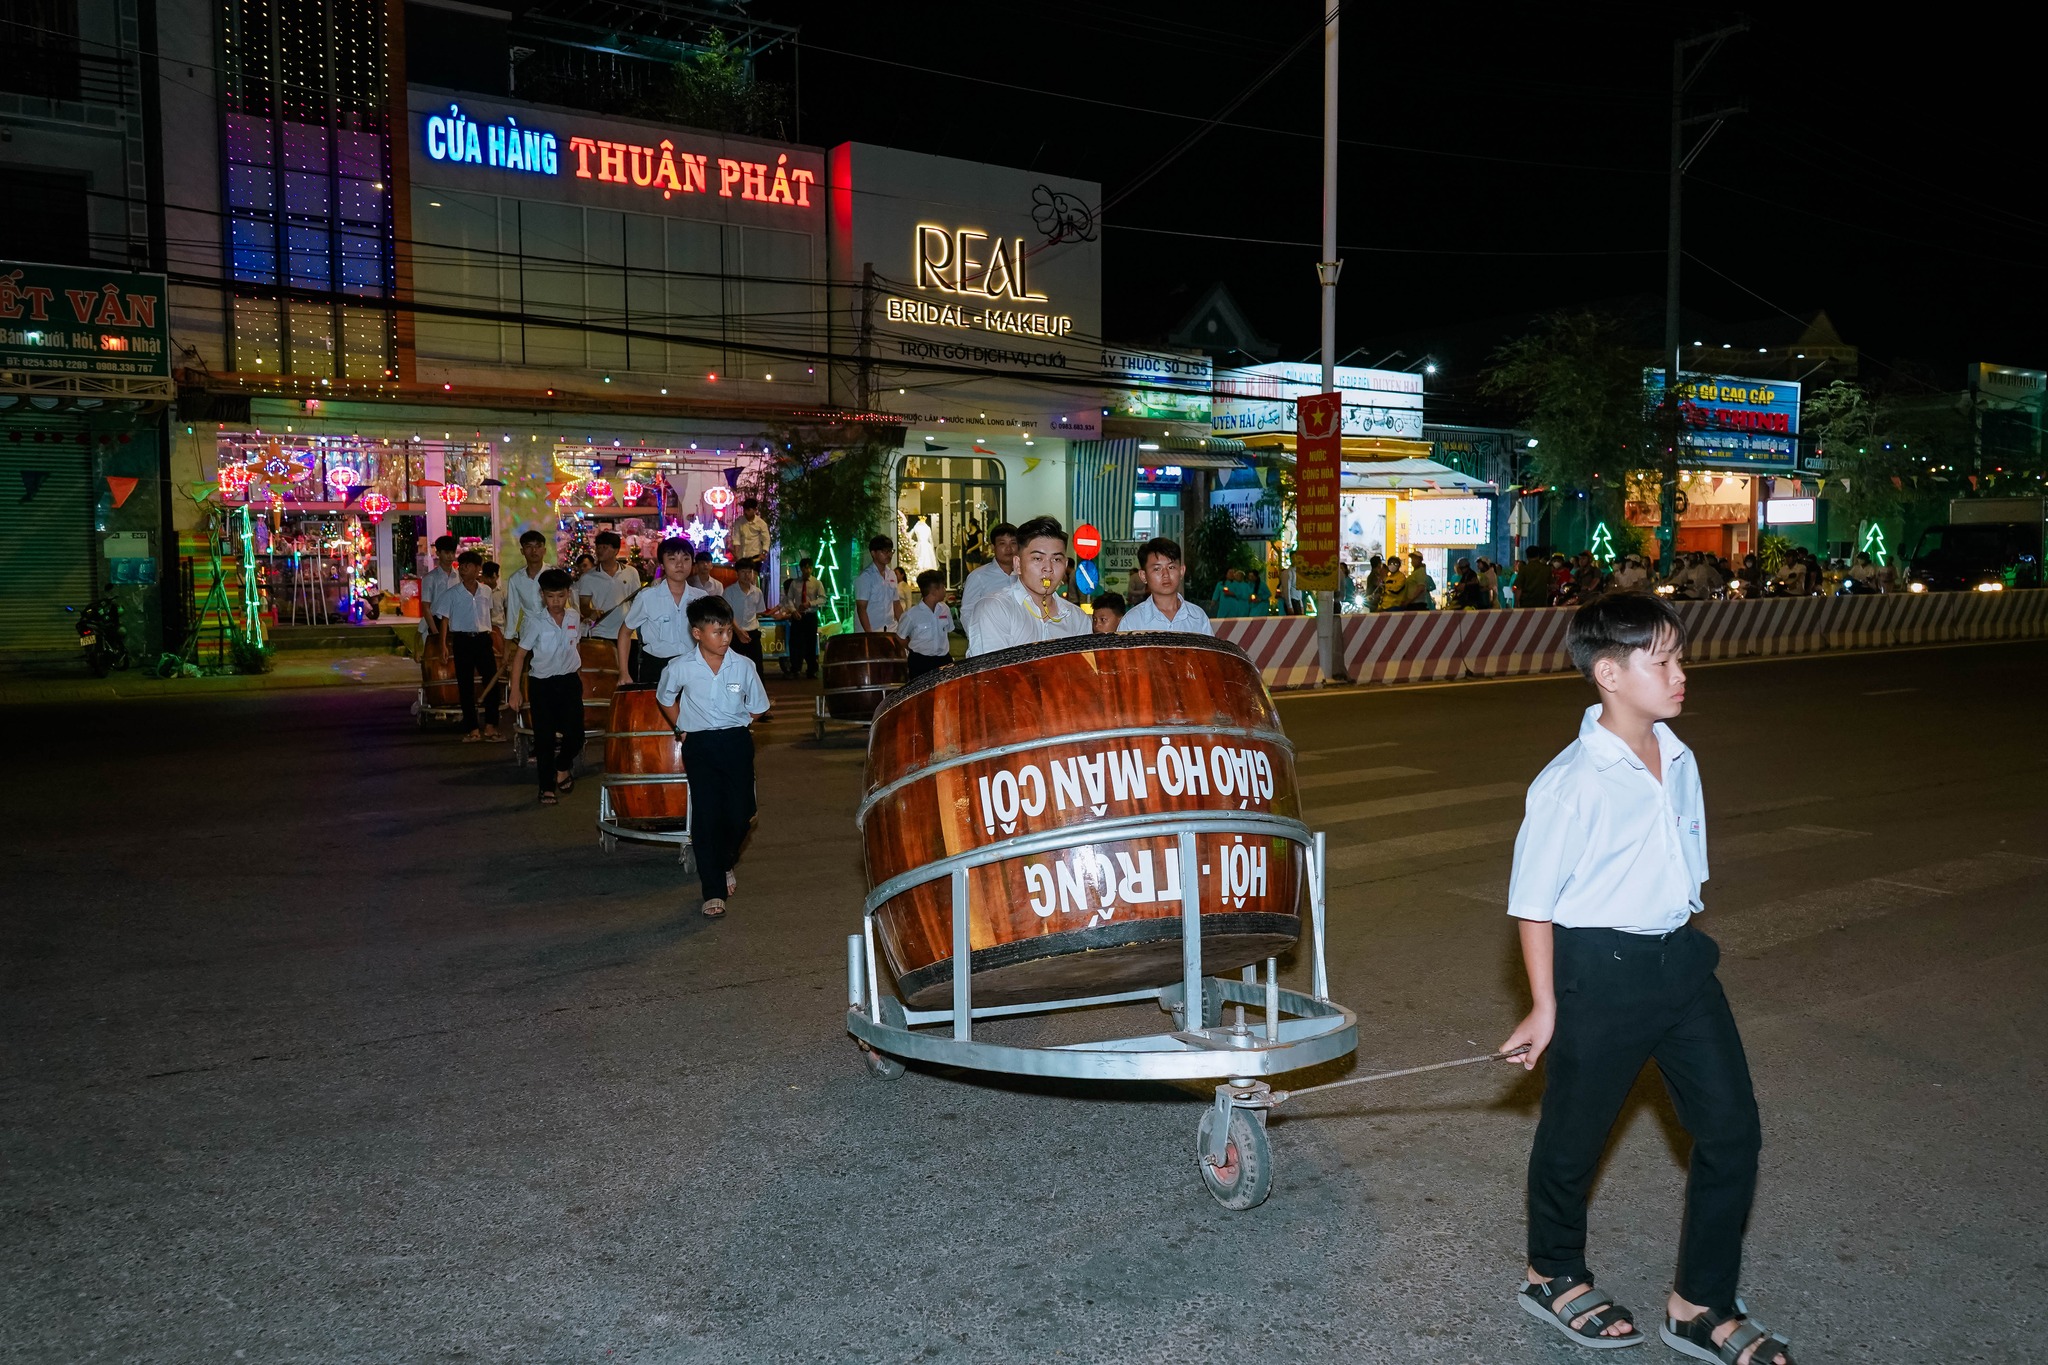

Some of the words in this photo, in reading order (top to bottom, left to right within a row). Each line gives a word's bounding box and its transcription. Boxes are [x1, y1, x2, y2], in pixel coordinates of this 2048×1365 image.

[427, 104, 482, 165] CỬA
[488, 117, 558, 176] HÀNG
[569, 138, 707, 200] THUẬN
[717, 153, 815, 208] PHÁT
[916, 224, 1050, 303] REAL
[65, 283, 157, 328] VÂN
[887, 298, 971, 329] BRIDAL
[985, 309, 1074, 338] MAKEUP
[132, 338, 161, 356] Nhật
[898, 341, 939, 361] TRỌN
[943, 342, 970, 361] GÓI
[973, 347, 1008, 366] DỊCH
[1011, 350, 1031, 369] VỤ
[1185, 361, 1208, 376] 155
[1720, 385, 1747, 404] CAO
[1749, 385, 1776, 405] CẤP
[1316, 521, 1333, 533] NAM
[1121, 558, 1133, 567] 155
[1210, 745, 1275, 809] GIÁO
[978, 764, 1047, 836] CÔI
[1023, 847, 1182, 928] TRỐNG
[1220, 835, 1267, 909] HỘI
